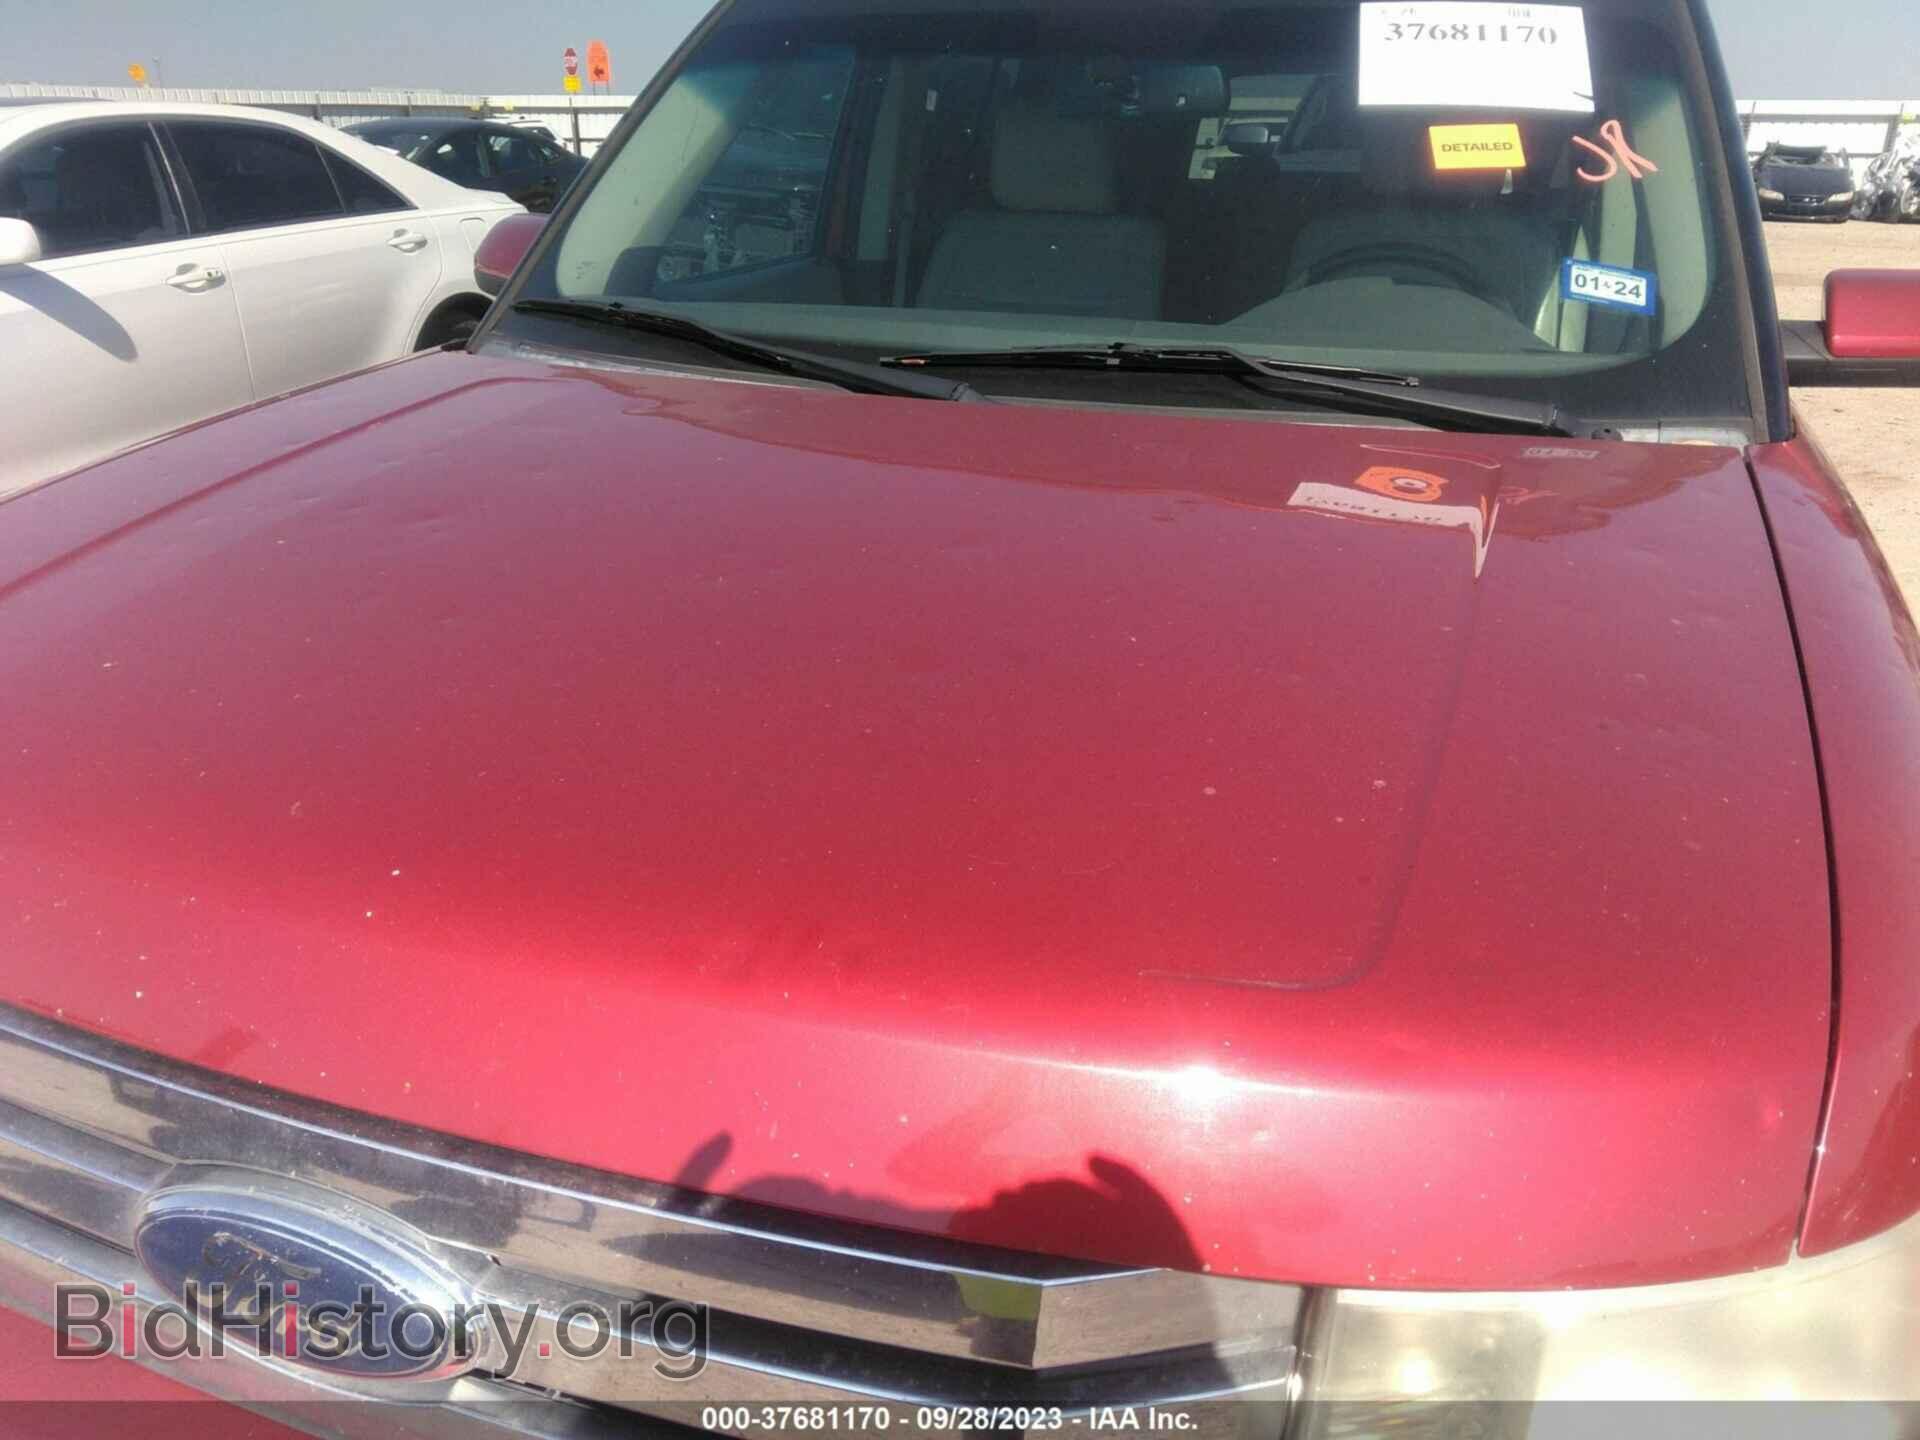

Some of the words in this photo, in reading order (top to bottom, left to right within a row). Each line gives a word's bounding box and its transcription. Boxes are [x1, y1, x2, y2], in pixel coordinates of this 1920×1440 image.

[1384, 23, 1557, 44] 37681170
[1441, 142, 1513, 152] DETAILED
[1575, 273, 1599, 291] 01
[1614, 281, 1642, 299] 24
